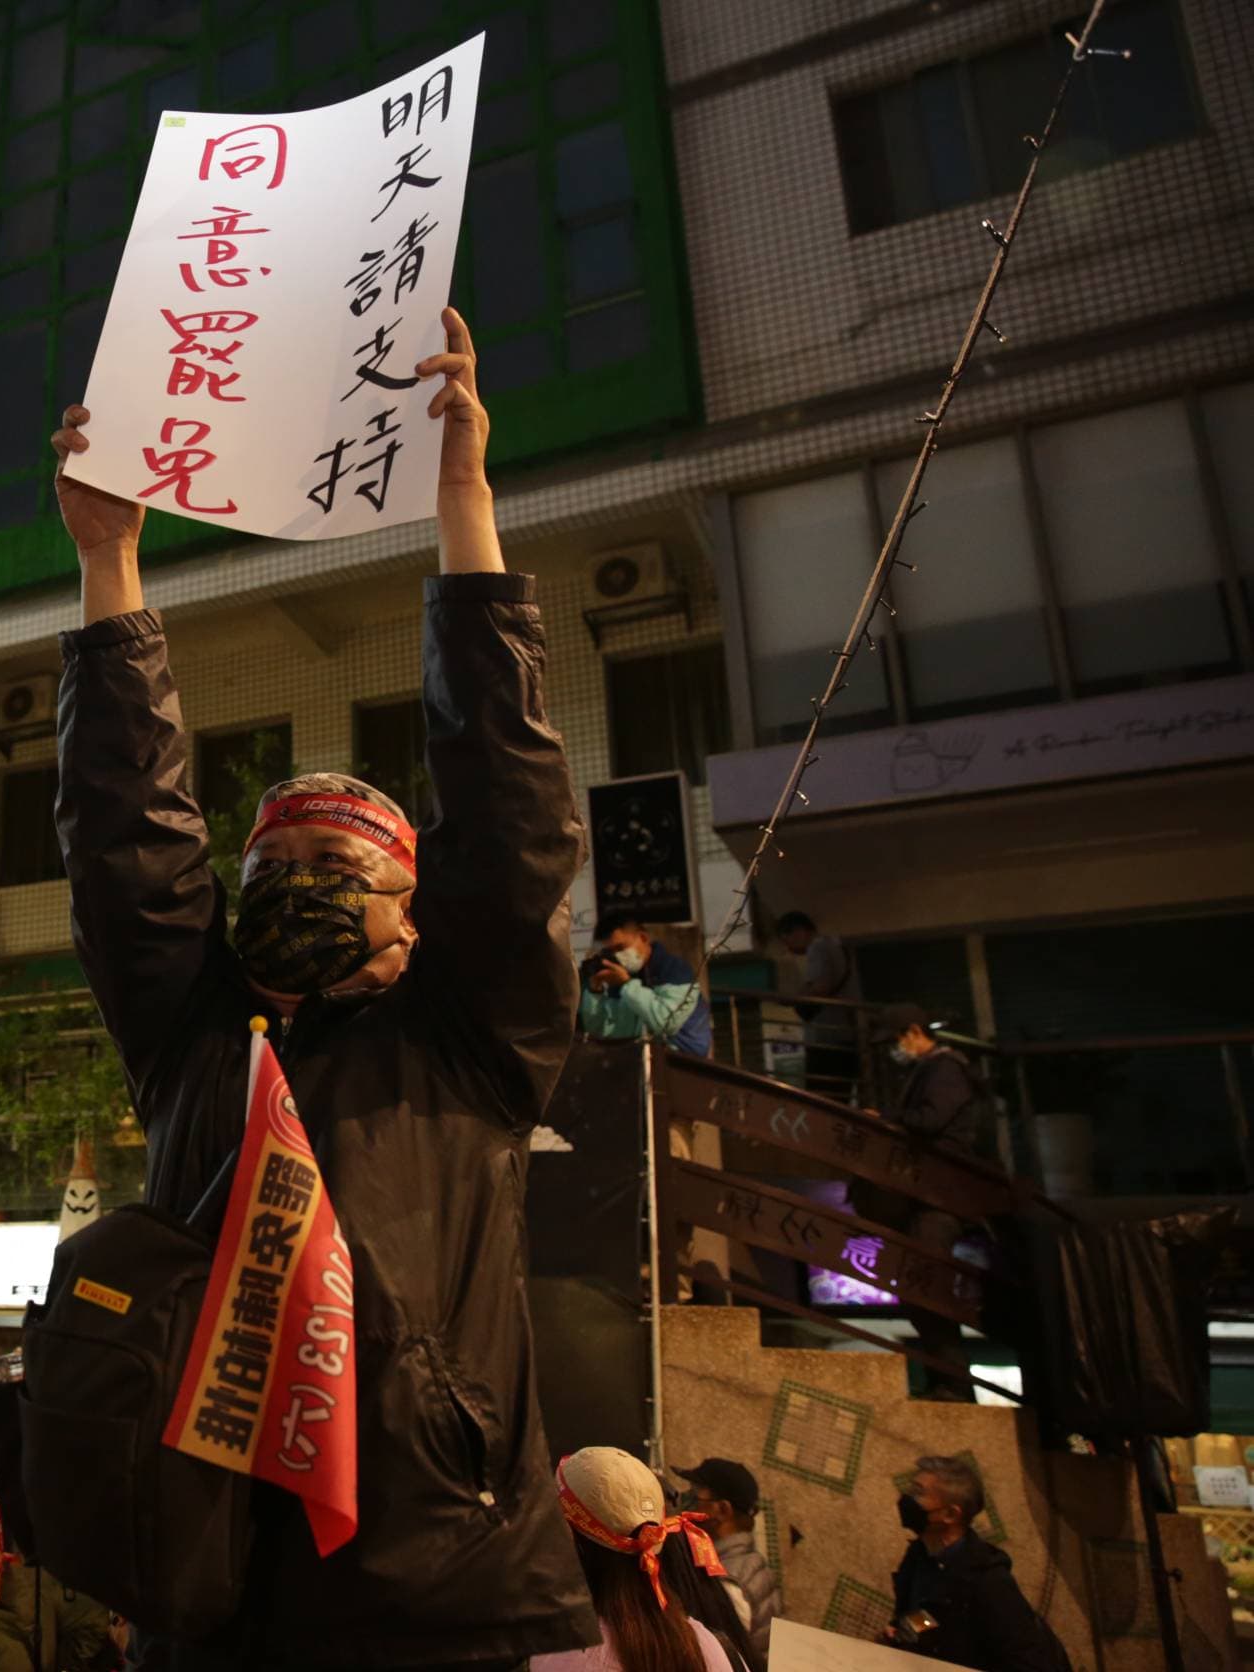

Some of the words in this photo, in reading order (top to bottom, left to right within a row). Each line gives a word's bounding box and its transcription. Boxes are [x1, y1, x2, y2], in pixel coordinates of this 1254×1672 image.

[137, 124, 287, 514] 同意罷免
[307, 65, 453, 514] 明天請支持
[301, 799, 352, 814] 1023
